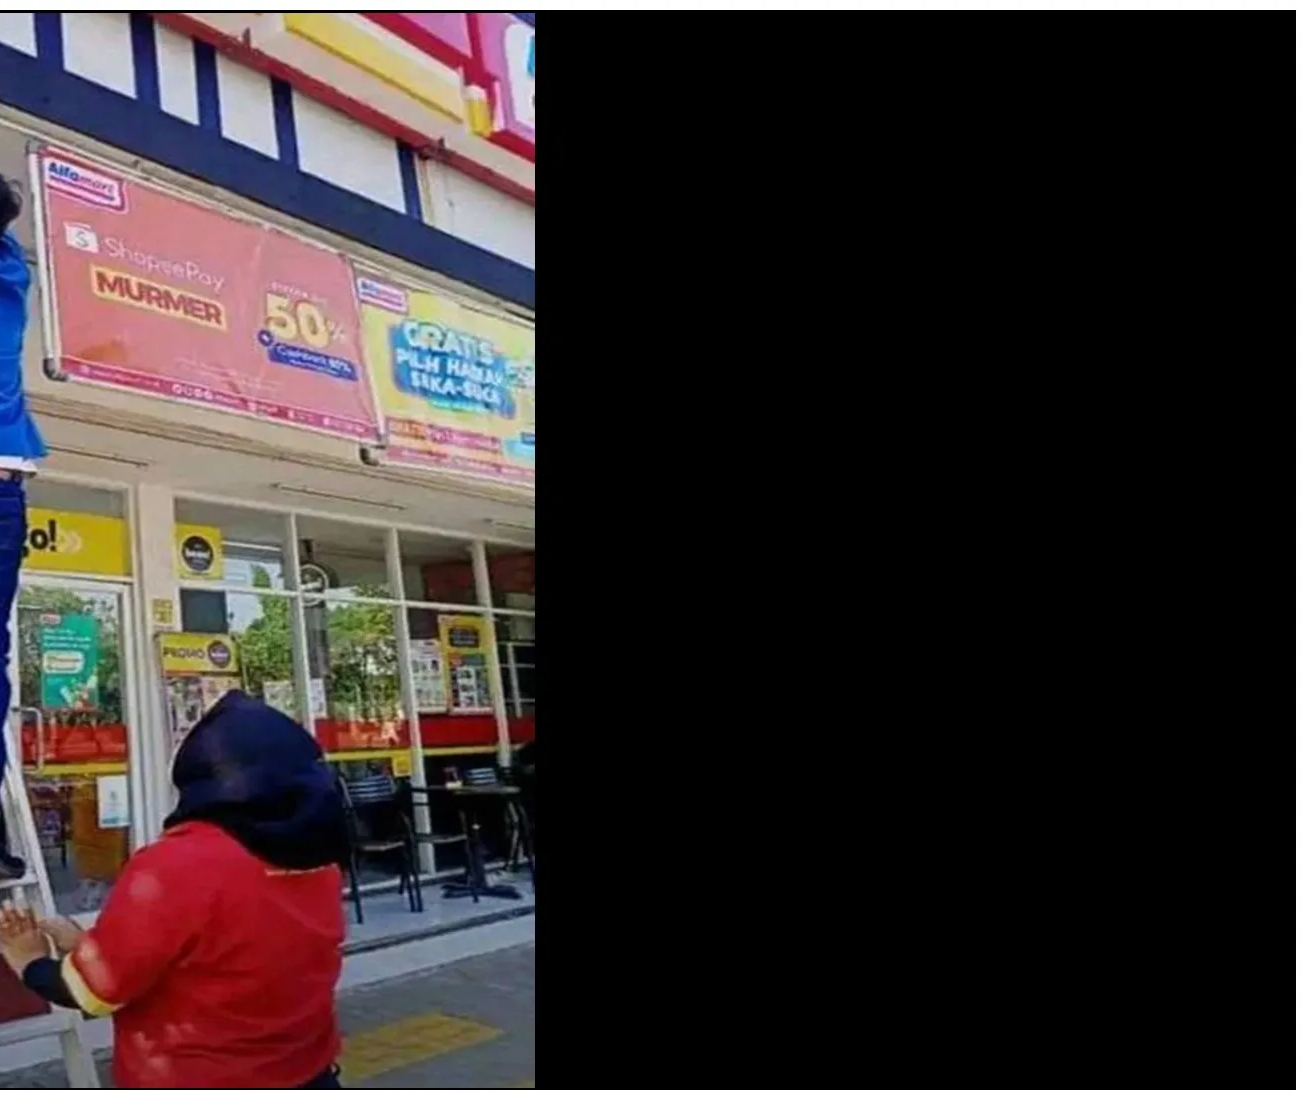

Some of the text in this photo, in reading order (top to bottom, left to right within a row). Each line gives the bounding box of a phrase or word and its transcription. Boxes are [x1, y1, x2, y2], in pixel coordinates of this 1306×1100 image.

[48, 161, 116, 195] Alfamart
[103, 237, 226, 294] ShopeePay
[95, 270, 224, 326] MURMER
[265, 292, 346, 349] 50%
[22, 518, 56, 557] o!
